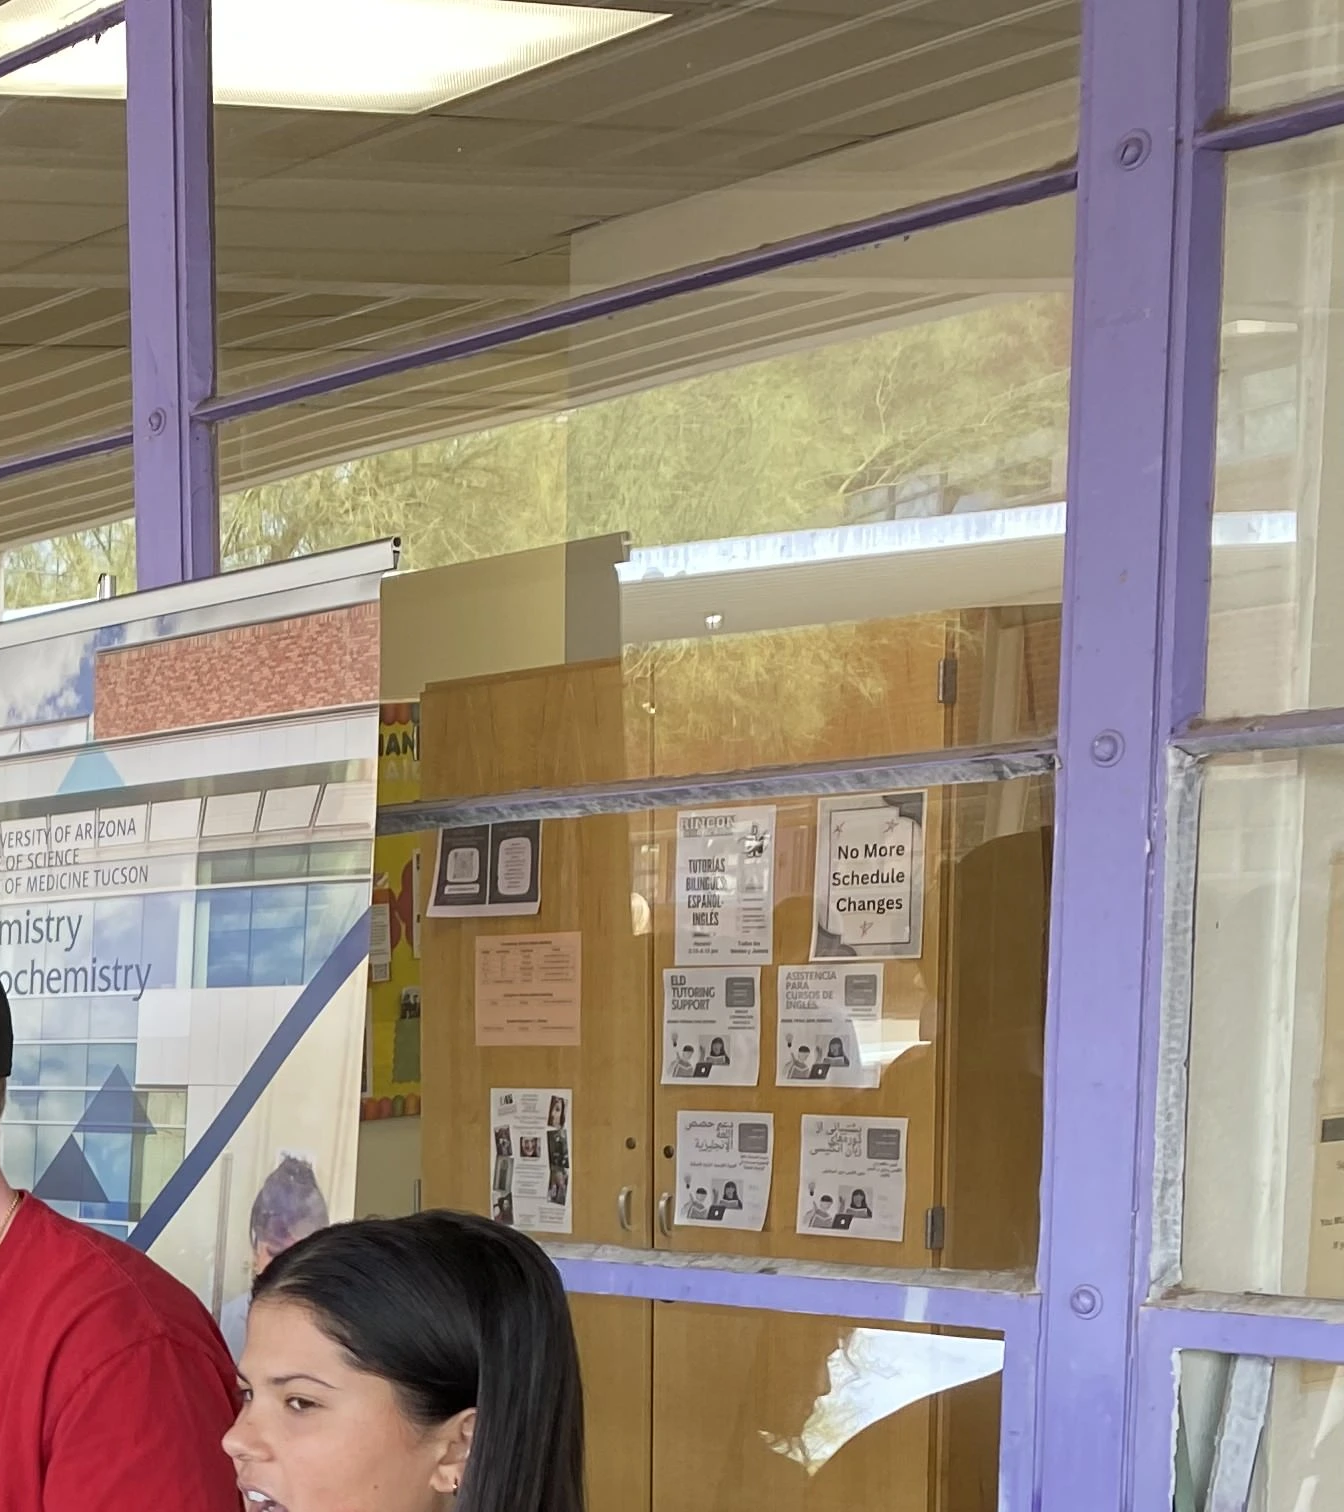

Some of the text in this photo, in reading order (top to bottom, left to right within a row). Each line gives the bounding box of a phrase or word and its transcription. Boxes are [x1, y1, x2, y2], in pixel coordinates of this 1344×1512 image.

[54, 825, 72, 842] OF
[75, 818, 136, 840] ARIZONA
[5, 853, 23, 871] OF
[28, 848, 80, 869] SCIENCE
[838, 843, 905, 860] No More
[4, 876, 22, 894] OF
[27, 870, 89, 892] MEDICINE
[94, 865, 149, 886] TUCSON
[832, 868, 905, 886] Schedule
[836, 897, 903, 914] Changes
[671, 975, 686, 986] ELD
[786, 982, 809, 990] PARA
[672, 987, 715, 998] TUTORING
[822, 990, 833, 1000] DE
[672, 999, 711, 1010] SUPPORT
